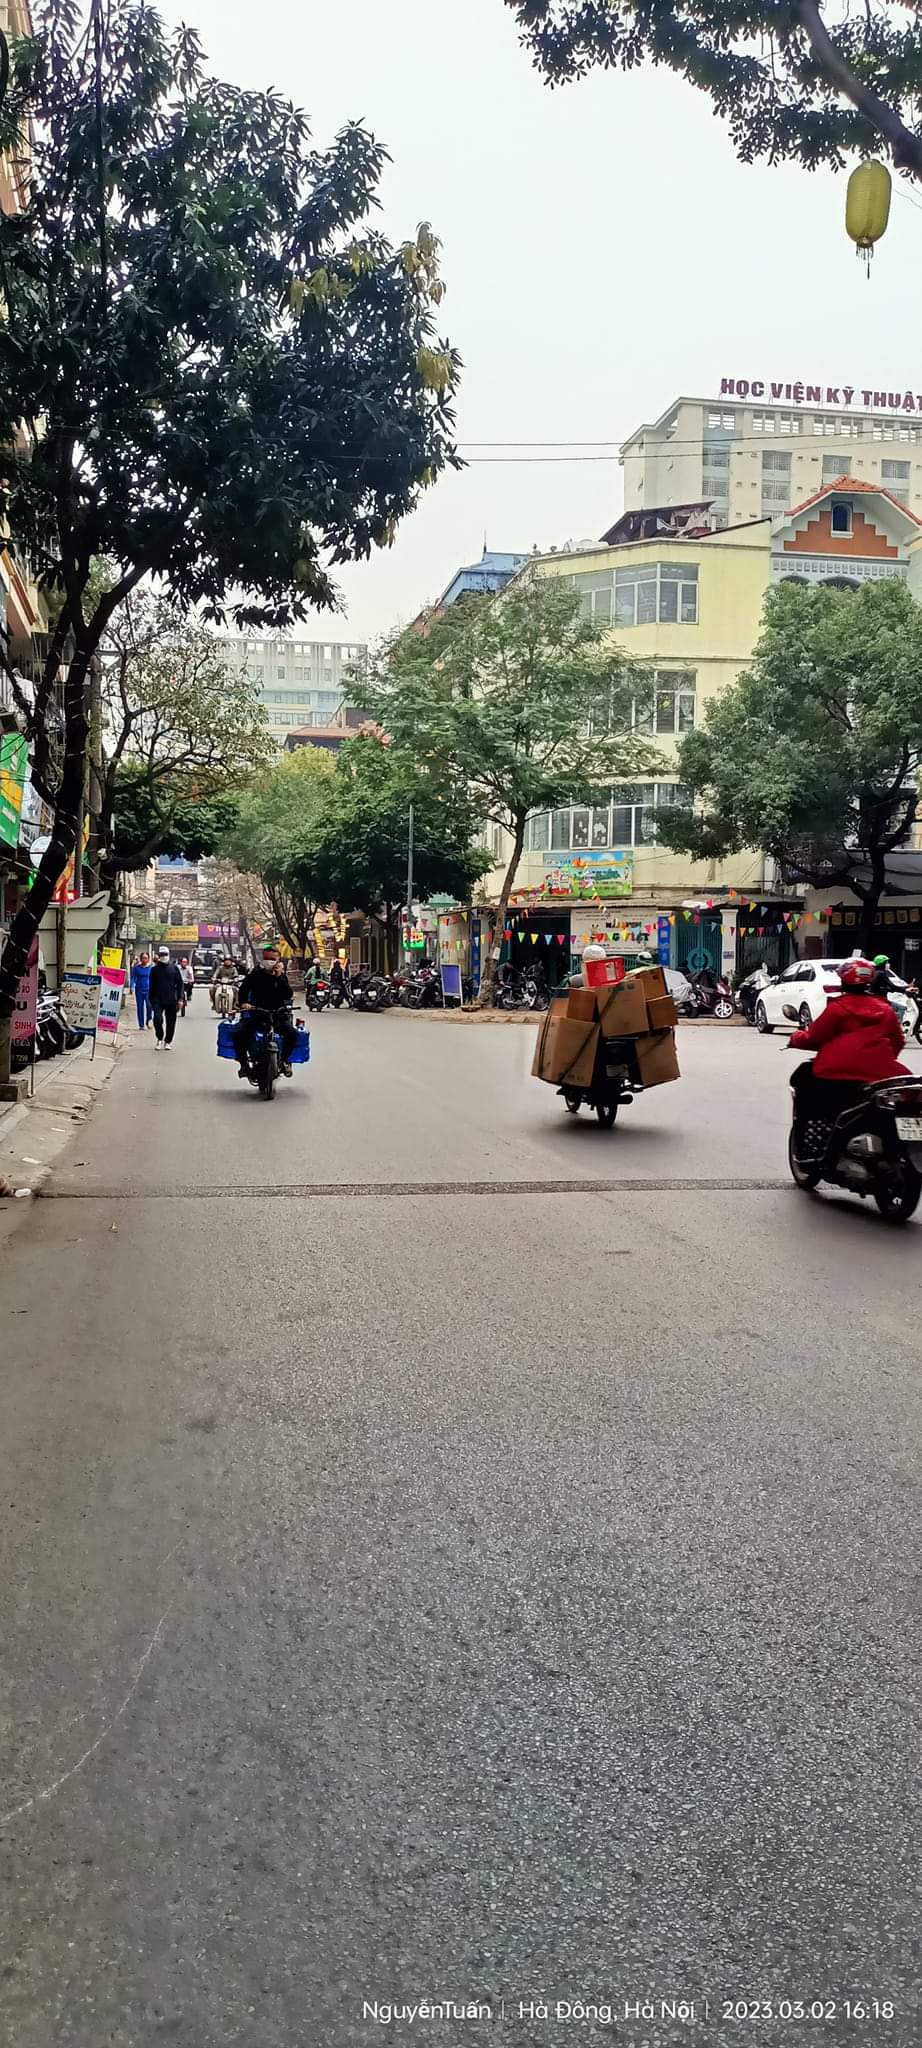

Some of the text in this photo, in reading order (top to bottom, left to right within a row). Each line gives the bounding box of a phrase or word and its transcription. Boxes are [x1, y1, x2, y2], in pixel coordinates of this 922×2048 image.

[721, 378, 764, 399] HỌC
[770, 382, 821, 403] VIỆN
[826, 386, 855, 405] KỸ
[14, 1022, 32, 1030] SINH
